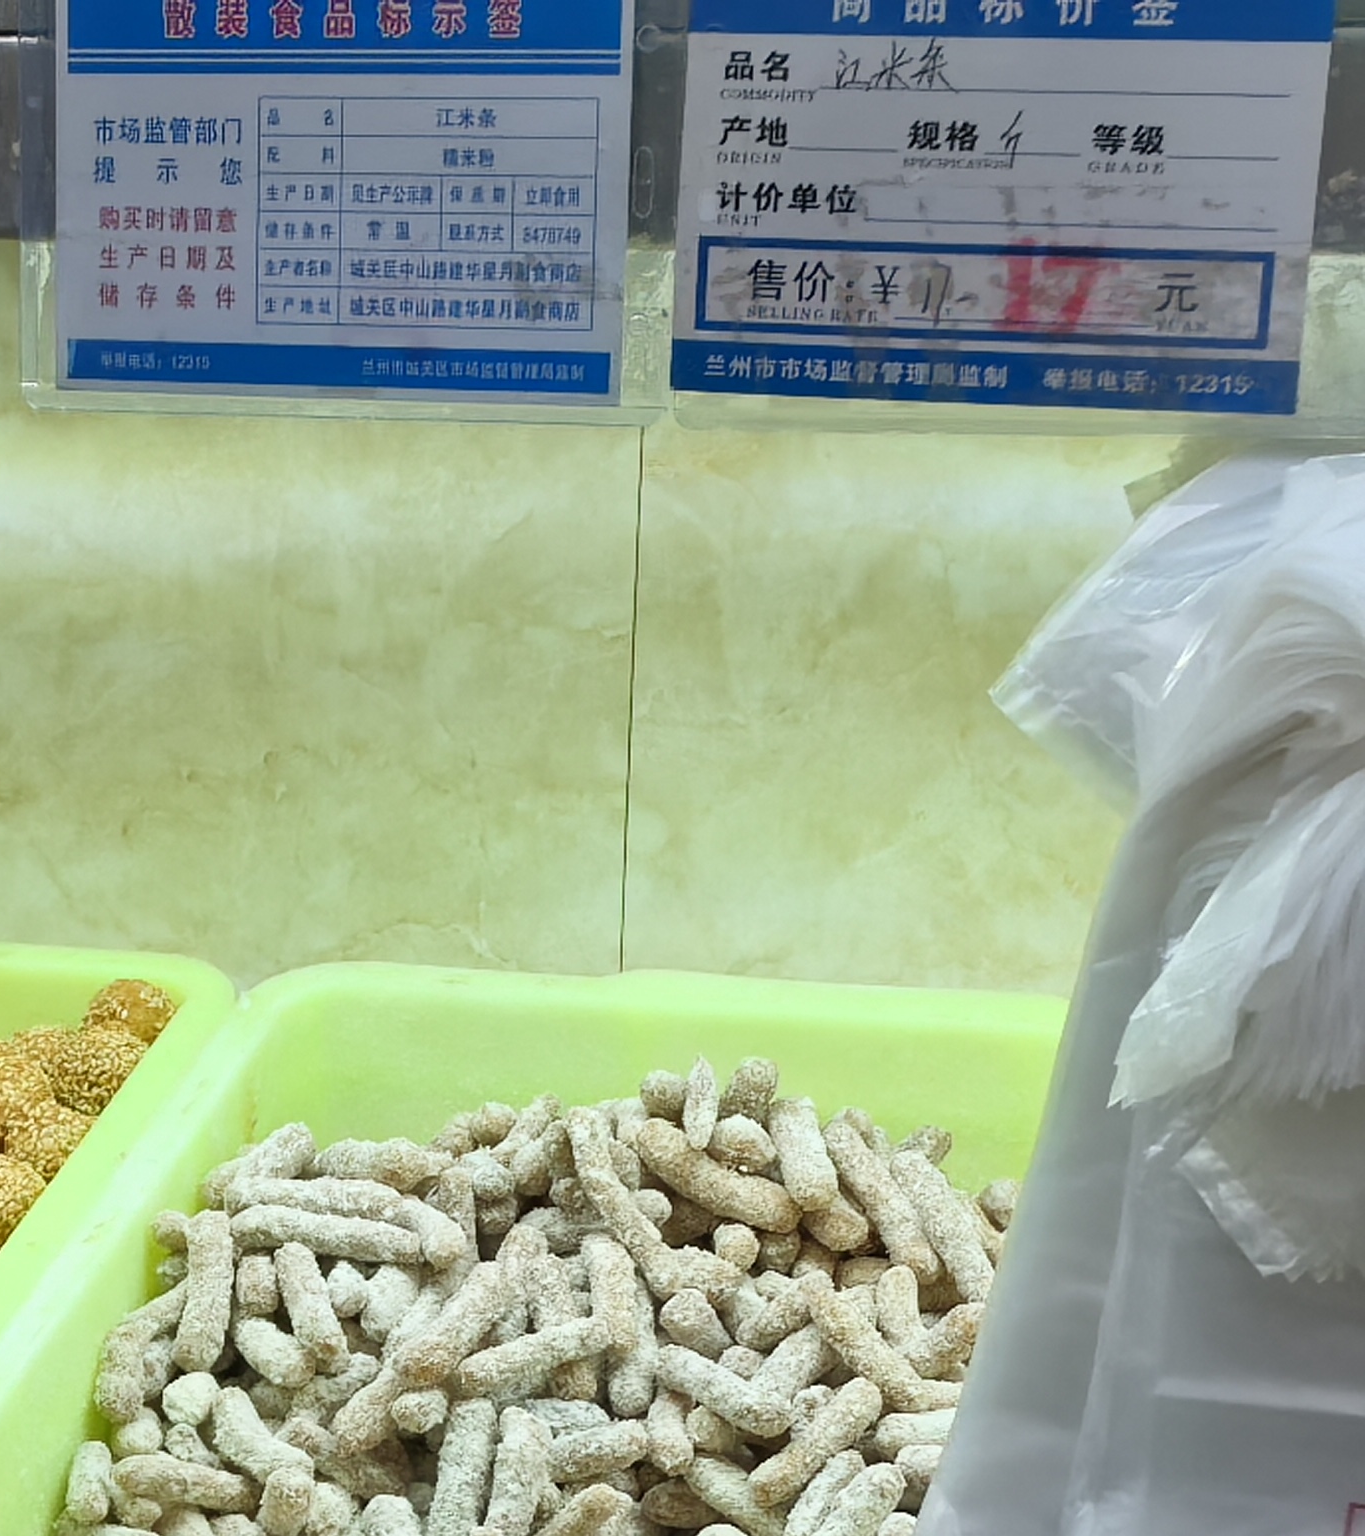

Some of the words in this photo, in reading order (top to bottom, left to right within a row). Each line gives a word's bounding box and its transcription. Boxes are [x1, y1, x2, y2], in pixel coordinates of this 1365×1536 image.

[164, 0, 521, 38] 散装食品标示签
[724, 50, 791, 82] 品名
[93, 116, 242, 145] 市场监管部门
[436, 107, 497, 128] 江米条
[719, 116, 788, 148] 产地
[906, 119, 979, 152] 规格
[1092, 124, 1167, 156] 等级
[93, 155, 242, 185] 提示您
[716, 181, 857, 214] 计价单位
[99, 205, 237, 233] 购买时请留意
[99, 244, 236, 272] 生产日期及
[99, 283, 236, 310] 储存条件
[995, 237, 1120, 333] 17
[1155, 273, 1199, 313] 元
[704, 354, 1008, 390] 兰州市市场监督管理局监制
[1175, 374, 1254, 397] 12315
